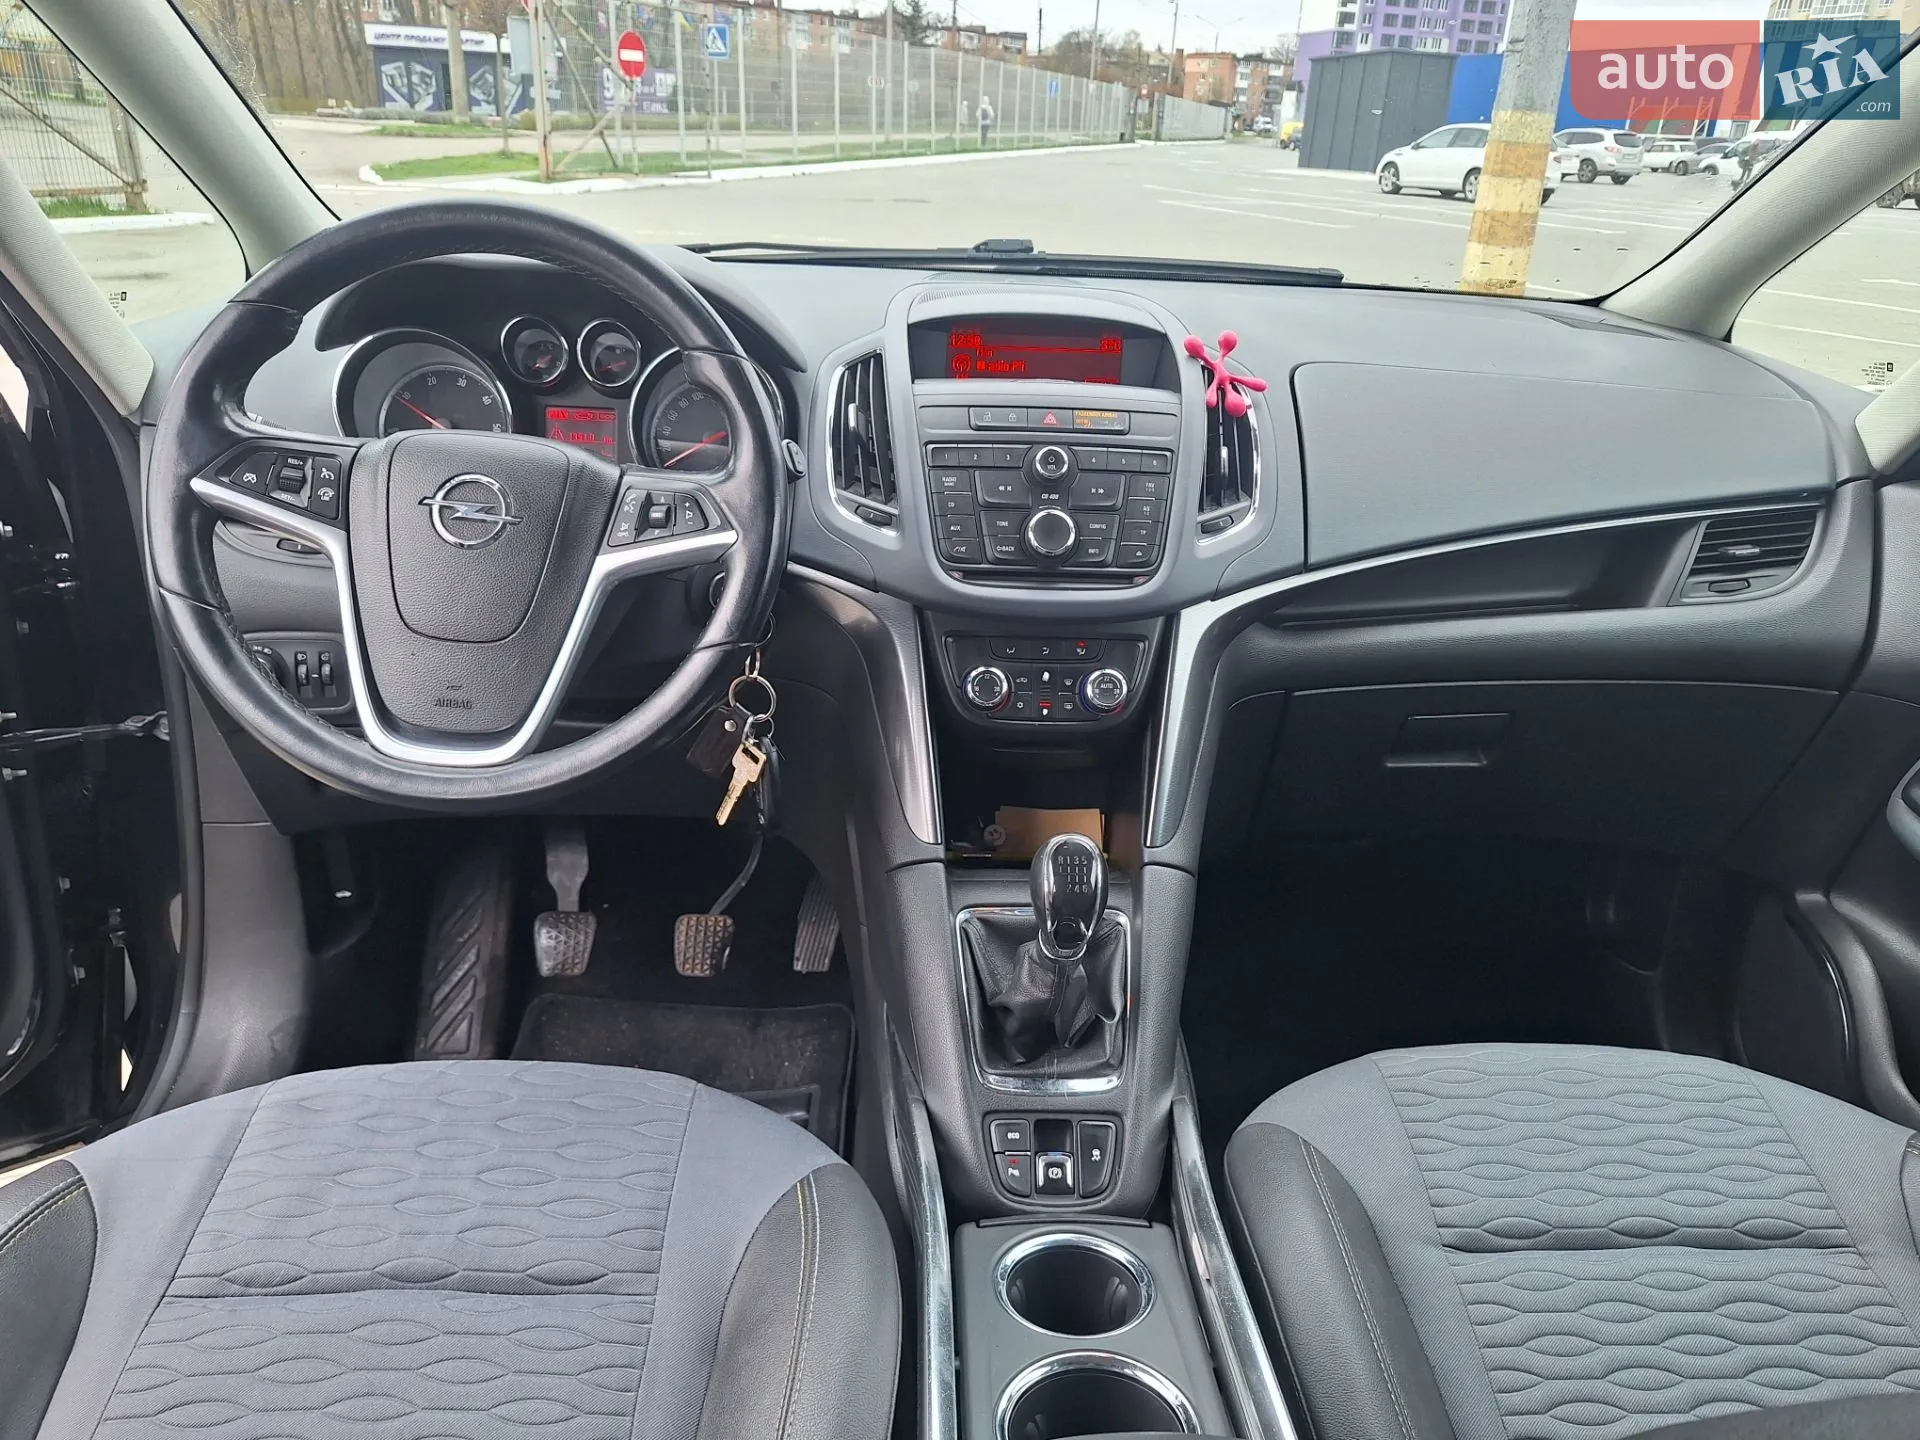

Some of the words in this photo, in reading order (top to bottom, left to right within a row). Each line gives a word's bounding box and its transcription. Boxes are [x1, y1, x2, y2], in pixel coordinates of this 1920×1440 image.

[427, 376, 437, 386] 20
[456, 377, 467, 388] 30
[482, 395, 492, 405] 40
[679, 397, 689, 409] 80
[668, 409, 679, 421] 60
[662, 425, 671, 437] 40
[1058, 855, 1064, 865] R
[1073, 855, 1080, 865] 3
[1081, 856, 1088, 865] 5
[1074, 884, 1080, 893] 4
